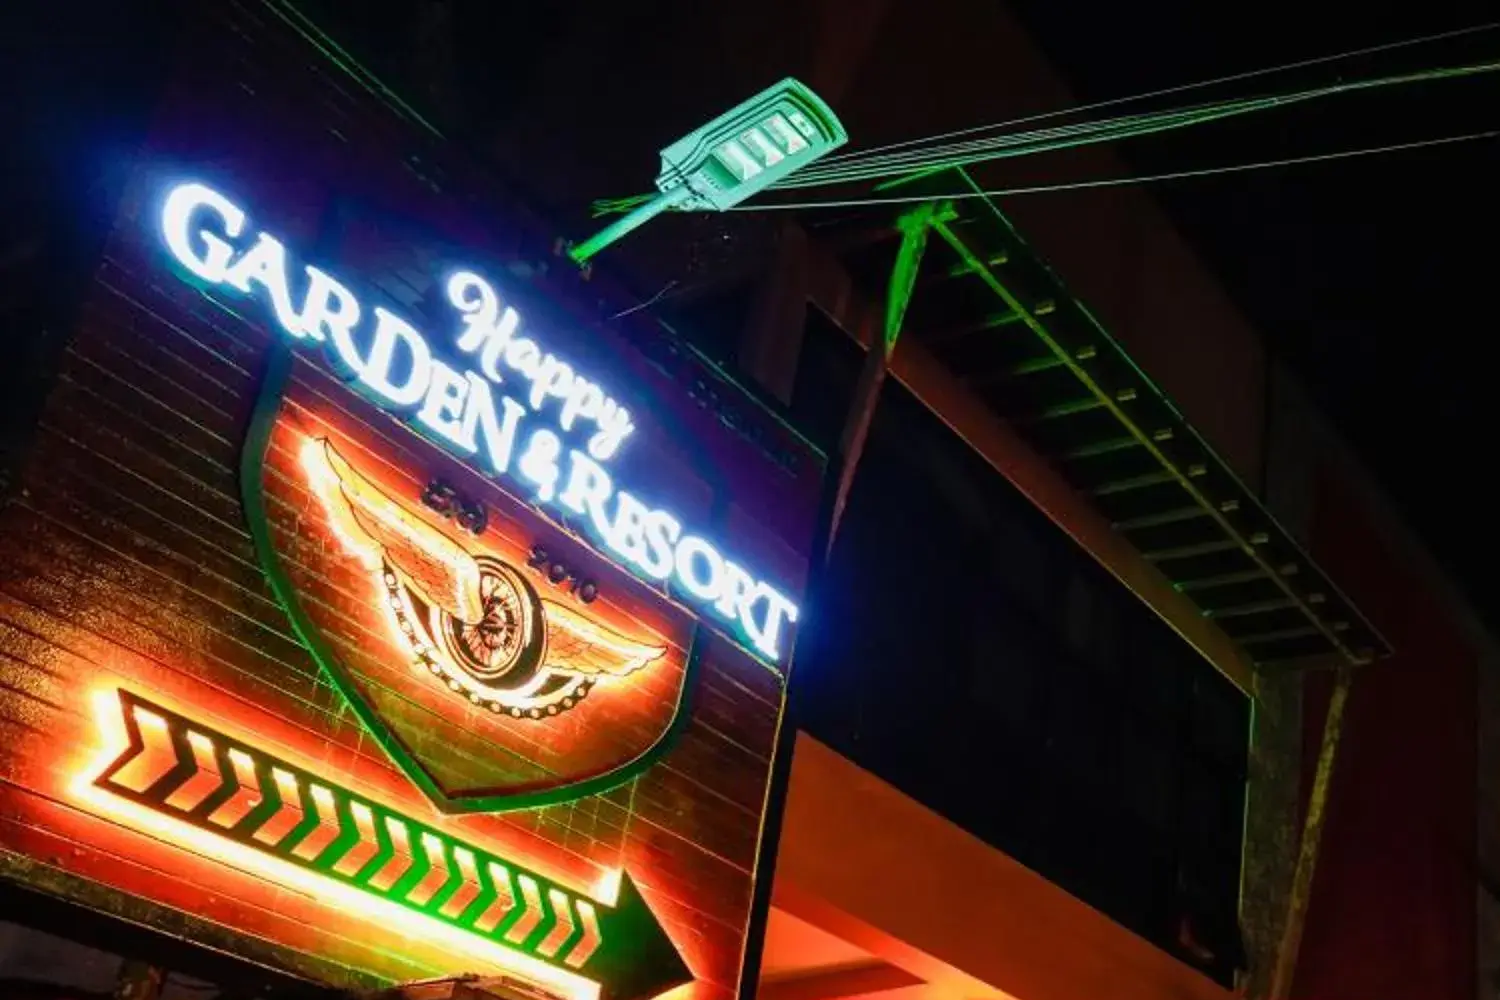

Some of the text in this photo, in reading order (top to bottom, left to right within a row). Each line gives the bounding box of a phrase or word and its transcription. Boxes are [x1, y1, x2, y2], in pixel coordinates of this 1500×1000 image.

[162, 184, 799, 660] GARDEN & RESORT
[447, 272, 635, 457] Happy
[527, 542, 598, 604] 2010
